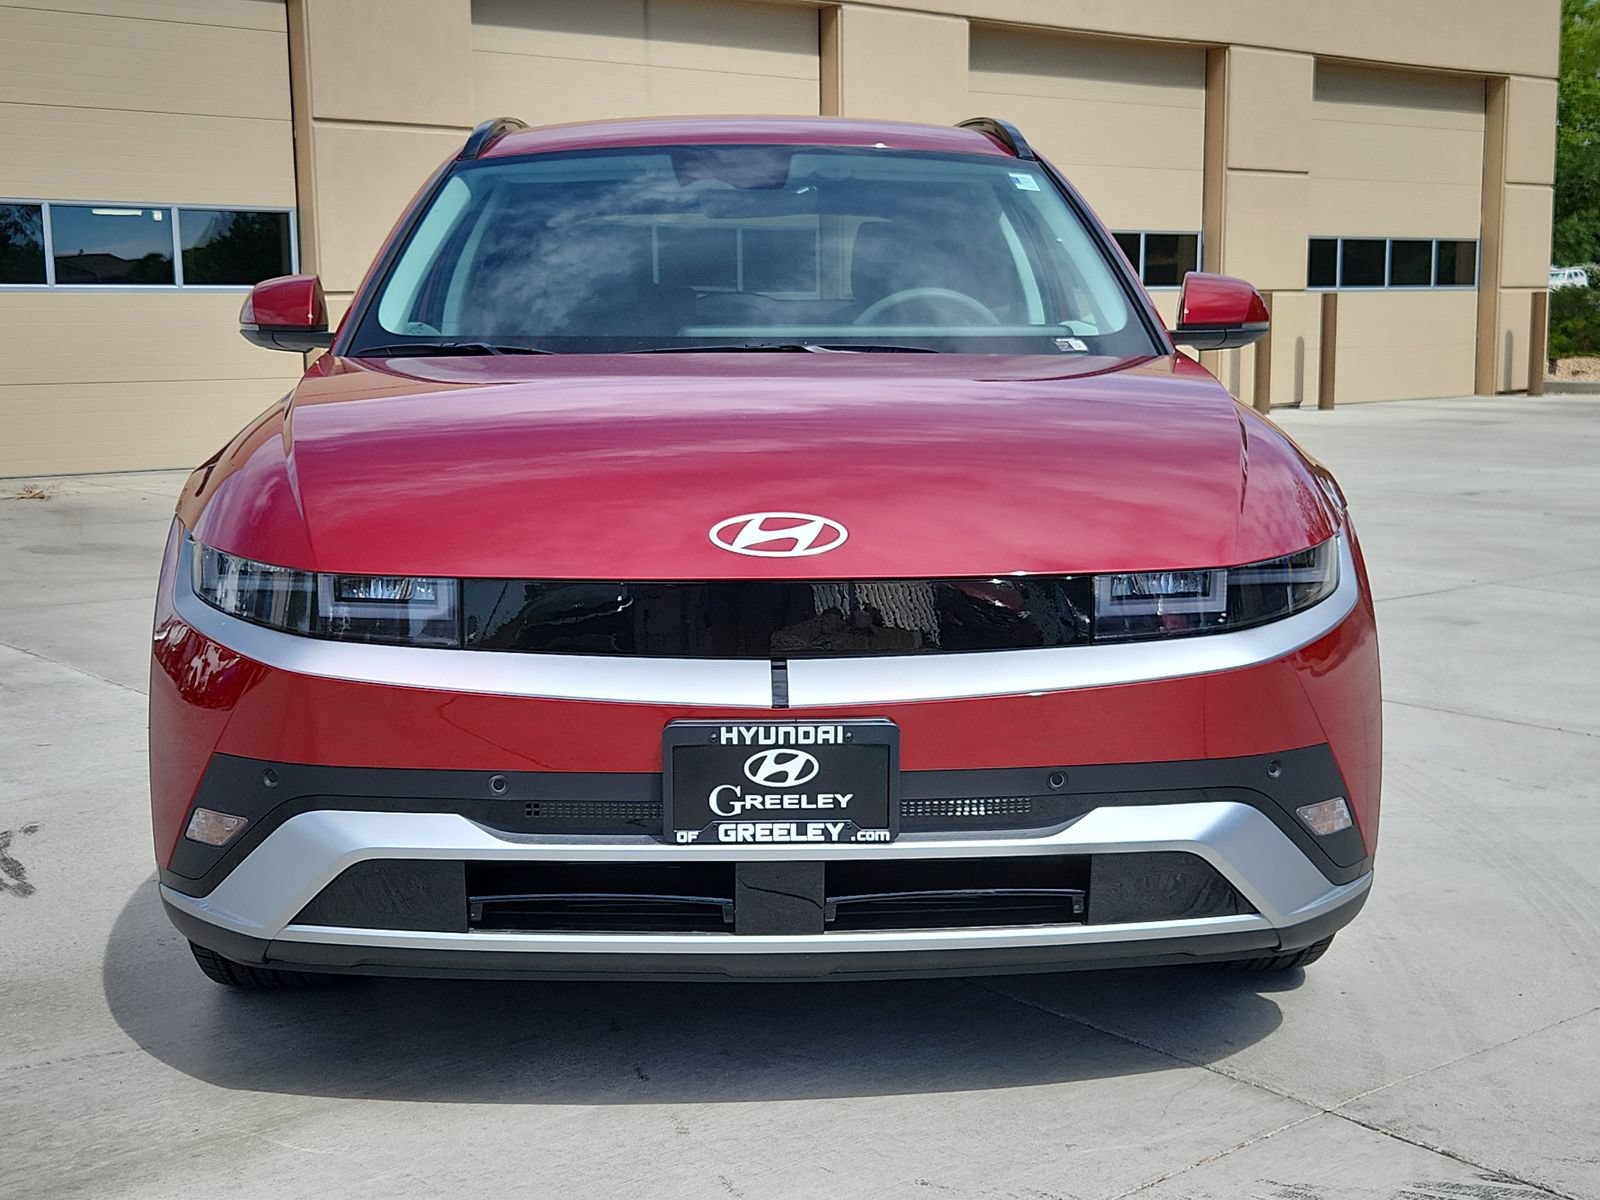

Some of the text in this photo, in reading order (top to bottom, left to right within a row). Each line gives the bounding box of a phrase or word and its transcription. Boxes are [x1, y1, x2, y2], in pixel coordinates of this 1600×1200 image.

[720, 726, 843, 745] HYUNDAI
[676, 823, 890, 843] OF GREELEY .com
